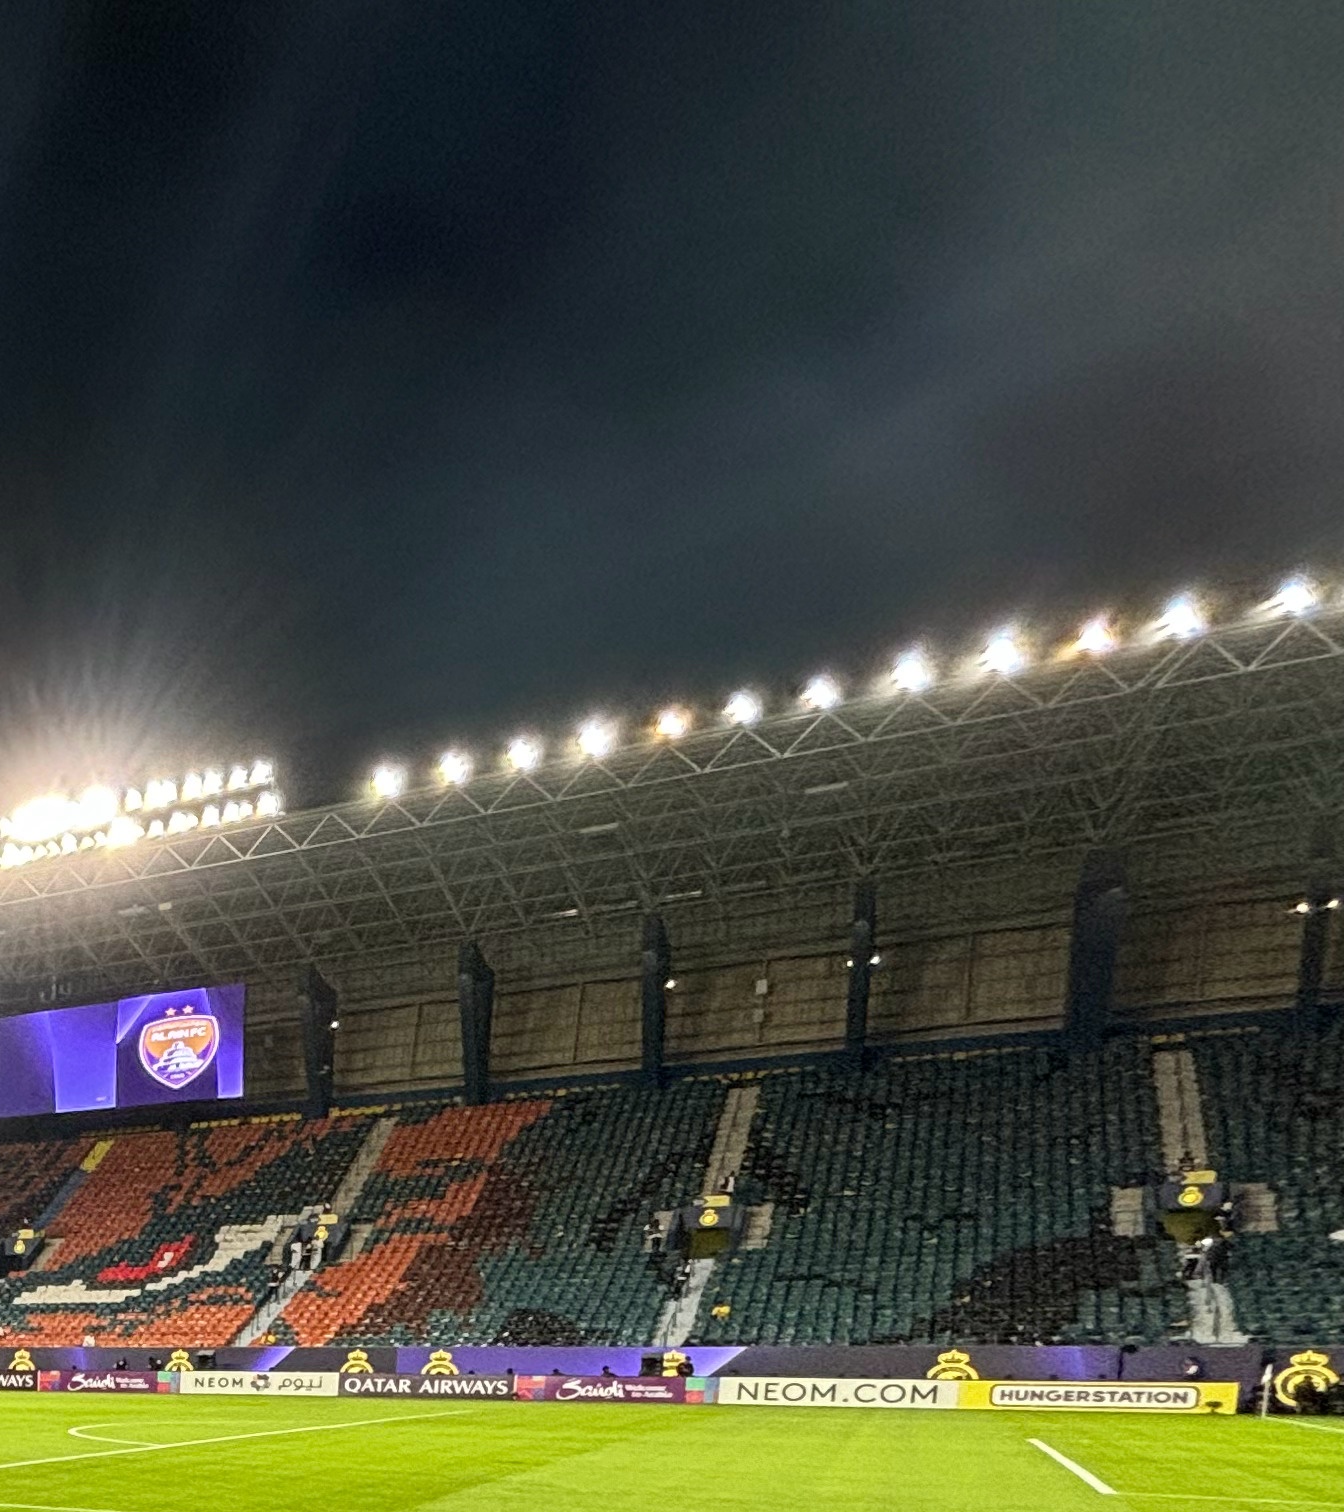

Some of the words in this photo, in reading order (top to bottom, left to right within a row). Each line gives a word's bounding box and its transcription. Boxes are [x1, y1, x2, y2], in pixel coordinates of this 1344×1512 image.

[190, 1026, 207, 1037] FC
[194, 1377, 244, 1388] NEOM
[344, 1377, 412, 1394] QATAR
[419, 1378, 509, 1395] AIRWAYS
[736, 1381, 939, 1404] NEOM.COM
[999, 1387, 1190, 1404] HUNGERSTATION
